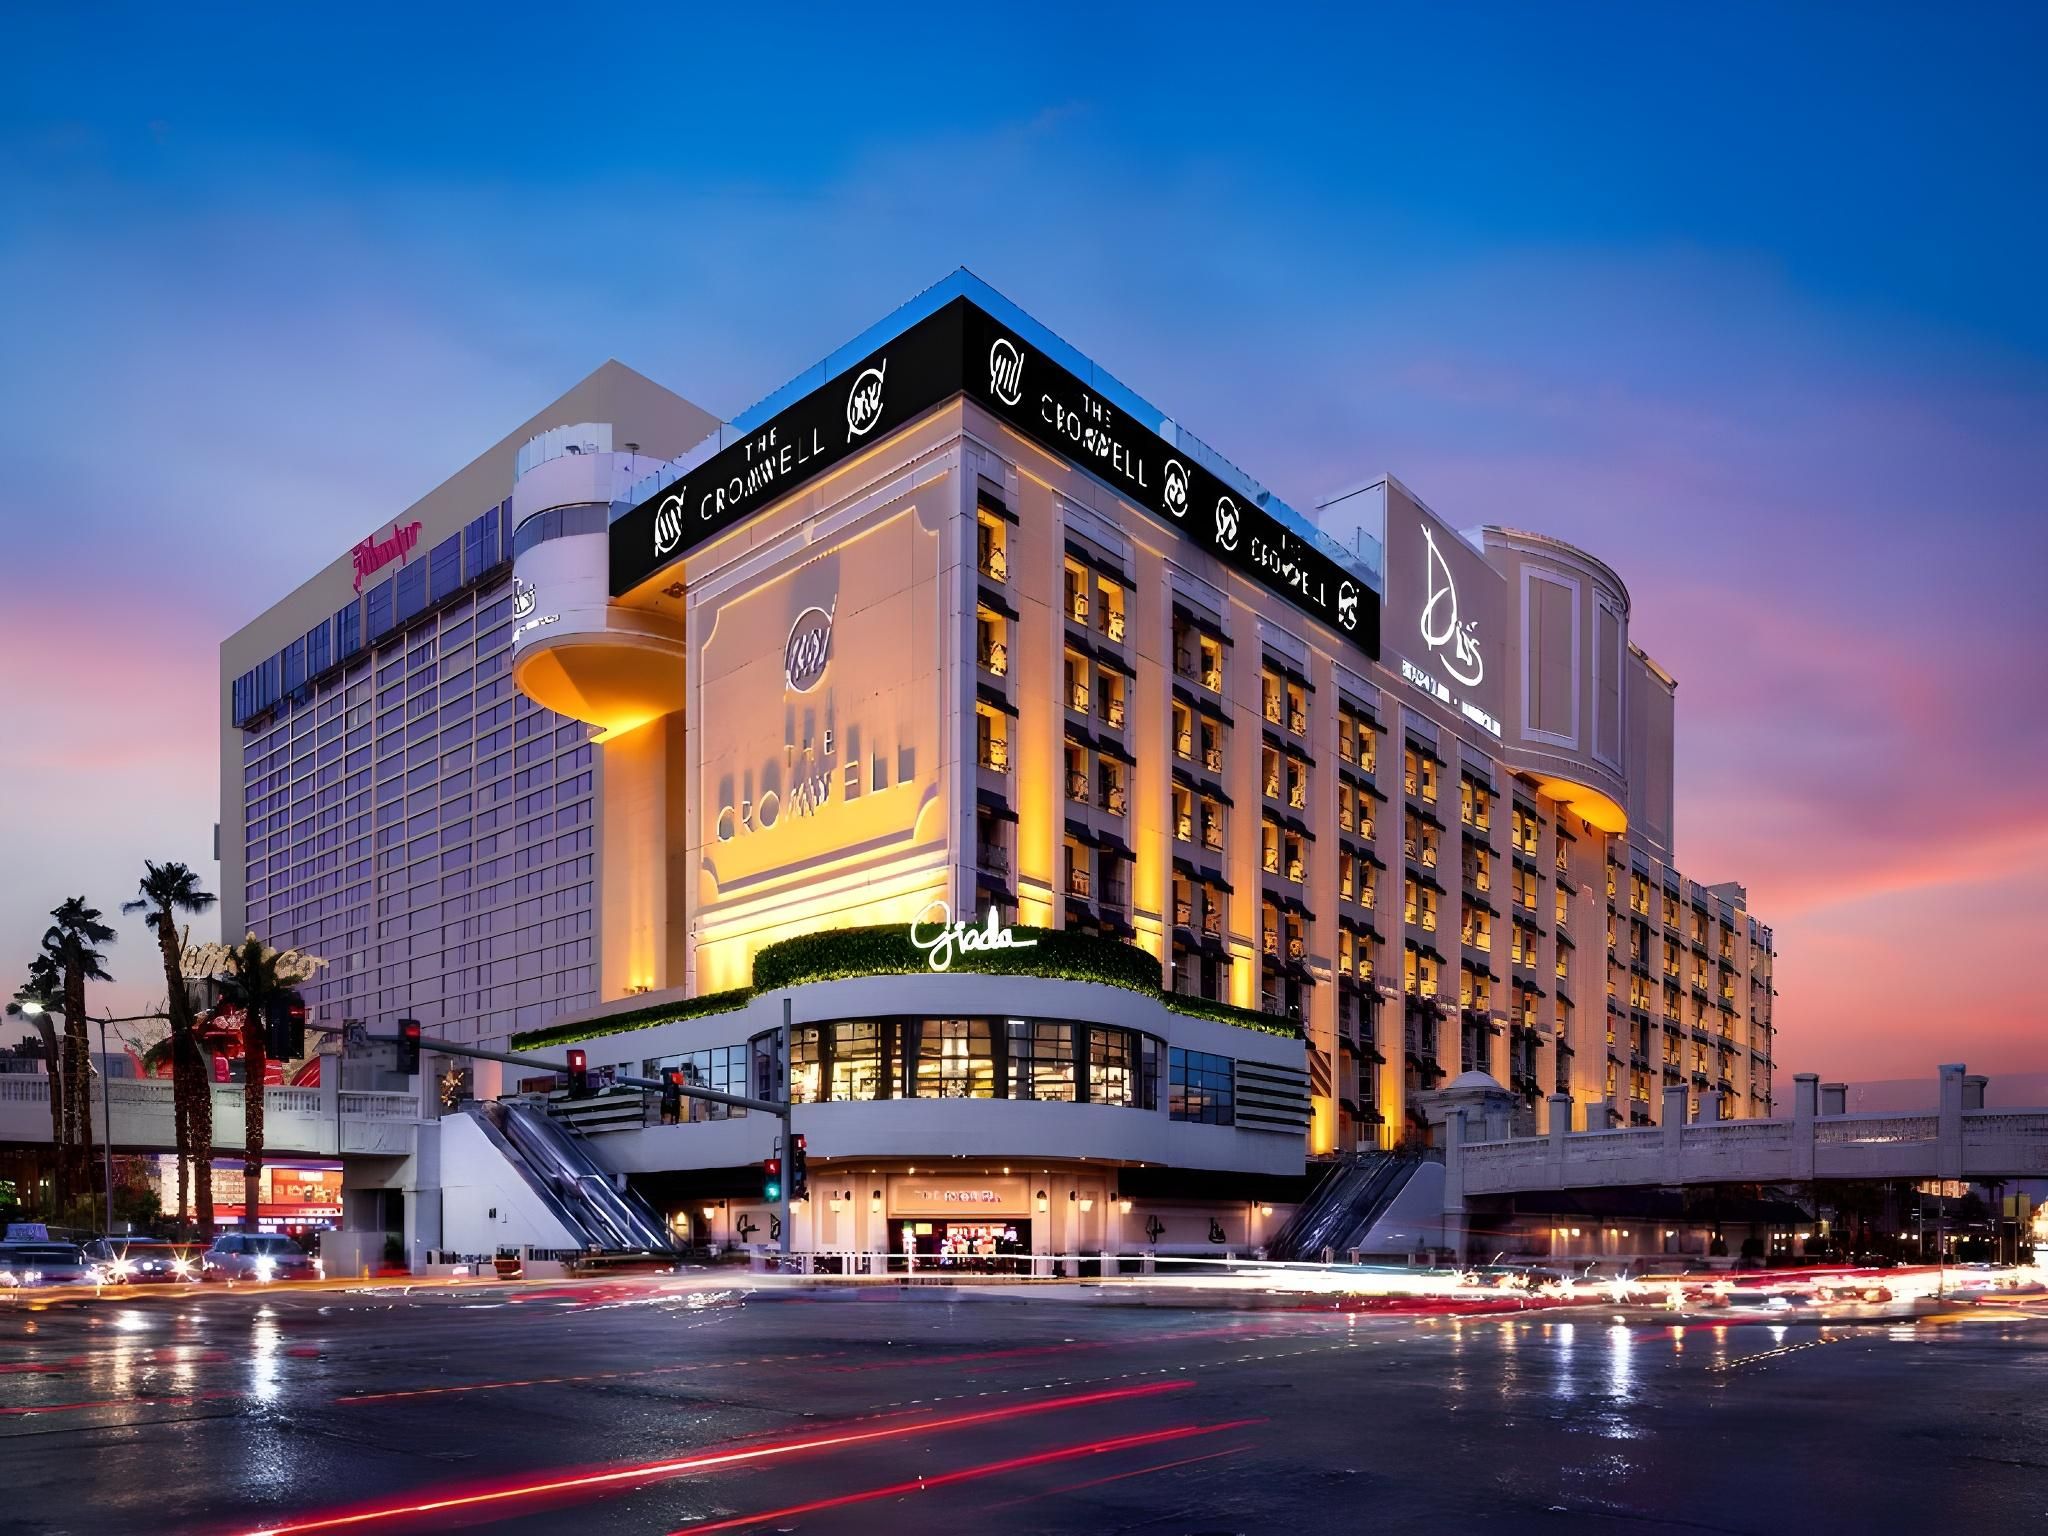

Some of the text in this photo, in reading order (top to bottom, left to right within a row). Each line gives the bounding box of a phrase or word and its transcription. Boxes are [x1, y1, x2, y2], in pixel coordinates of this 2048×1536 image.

[1082, 393, 1112, 429] THE
[745, 426, 777, 462] THE
[910, 900, 1038, 972] Giada
